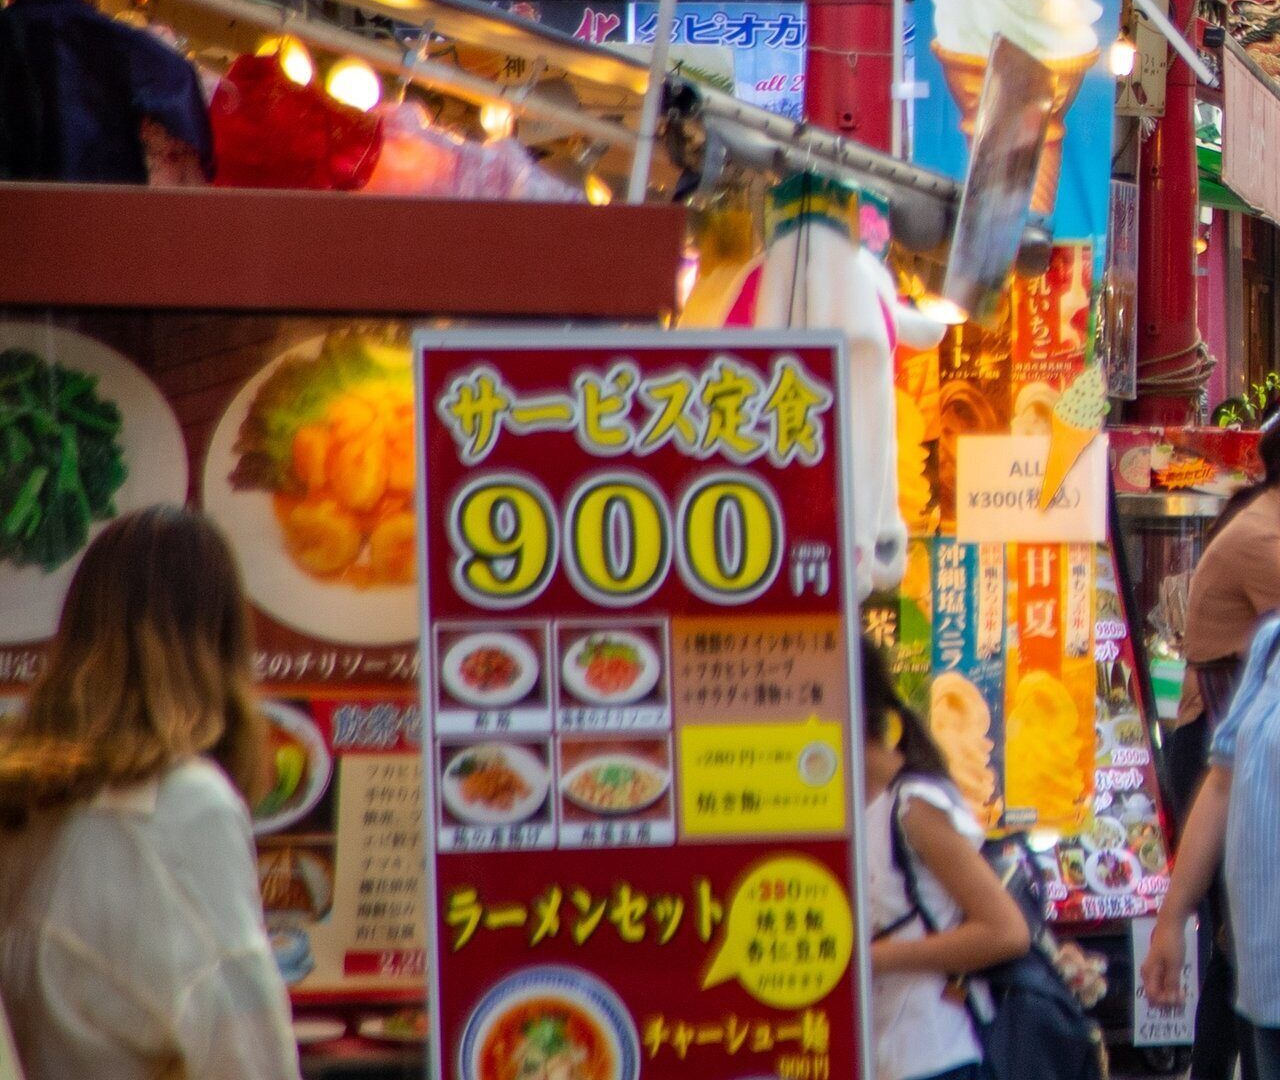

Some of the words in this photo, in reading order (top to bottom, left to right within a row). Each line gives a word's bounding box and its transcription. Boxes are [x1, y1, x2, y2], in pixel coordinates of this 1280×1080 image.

[440, 358, 834, 467] サービス定食
[1008, 459, 1045, 478] ALL
[1021, 547, 1058, 639] 甘夏
[446, 877, 726, 952] ラーメンセット
